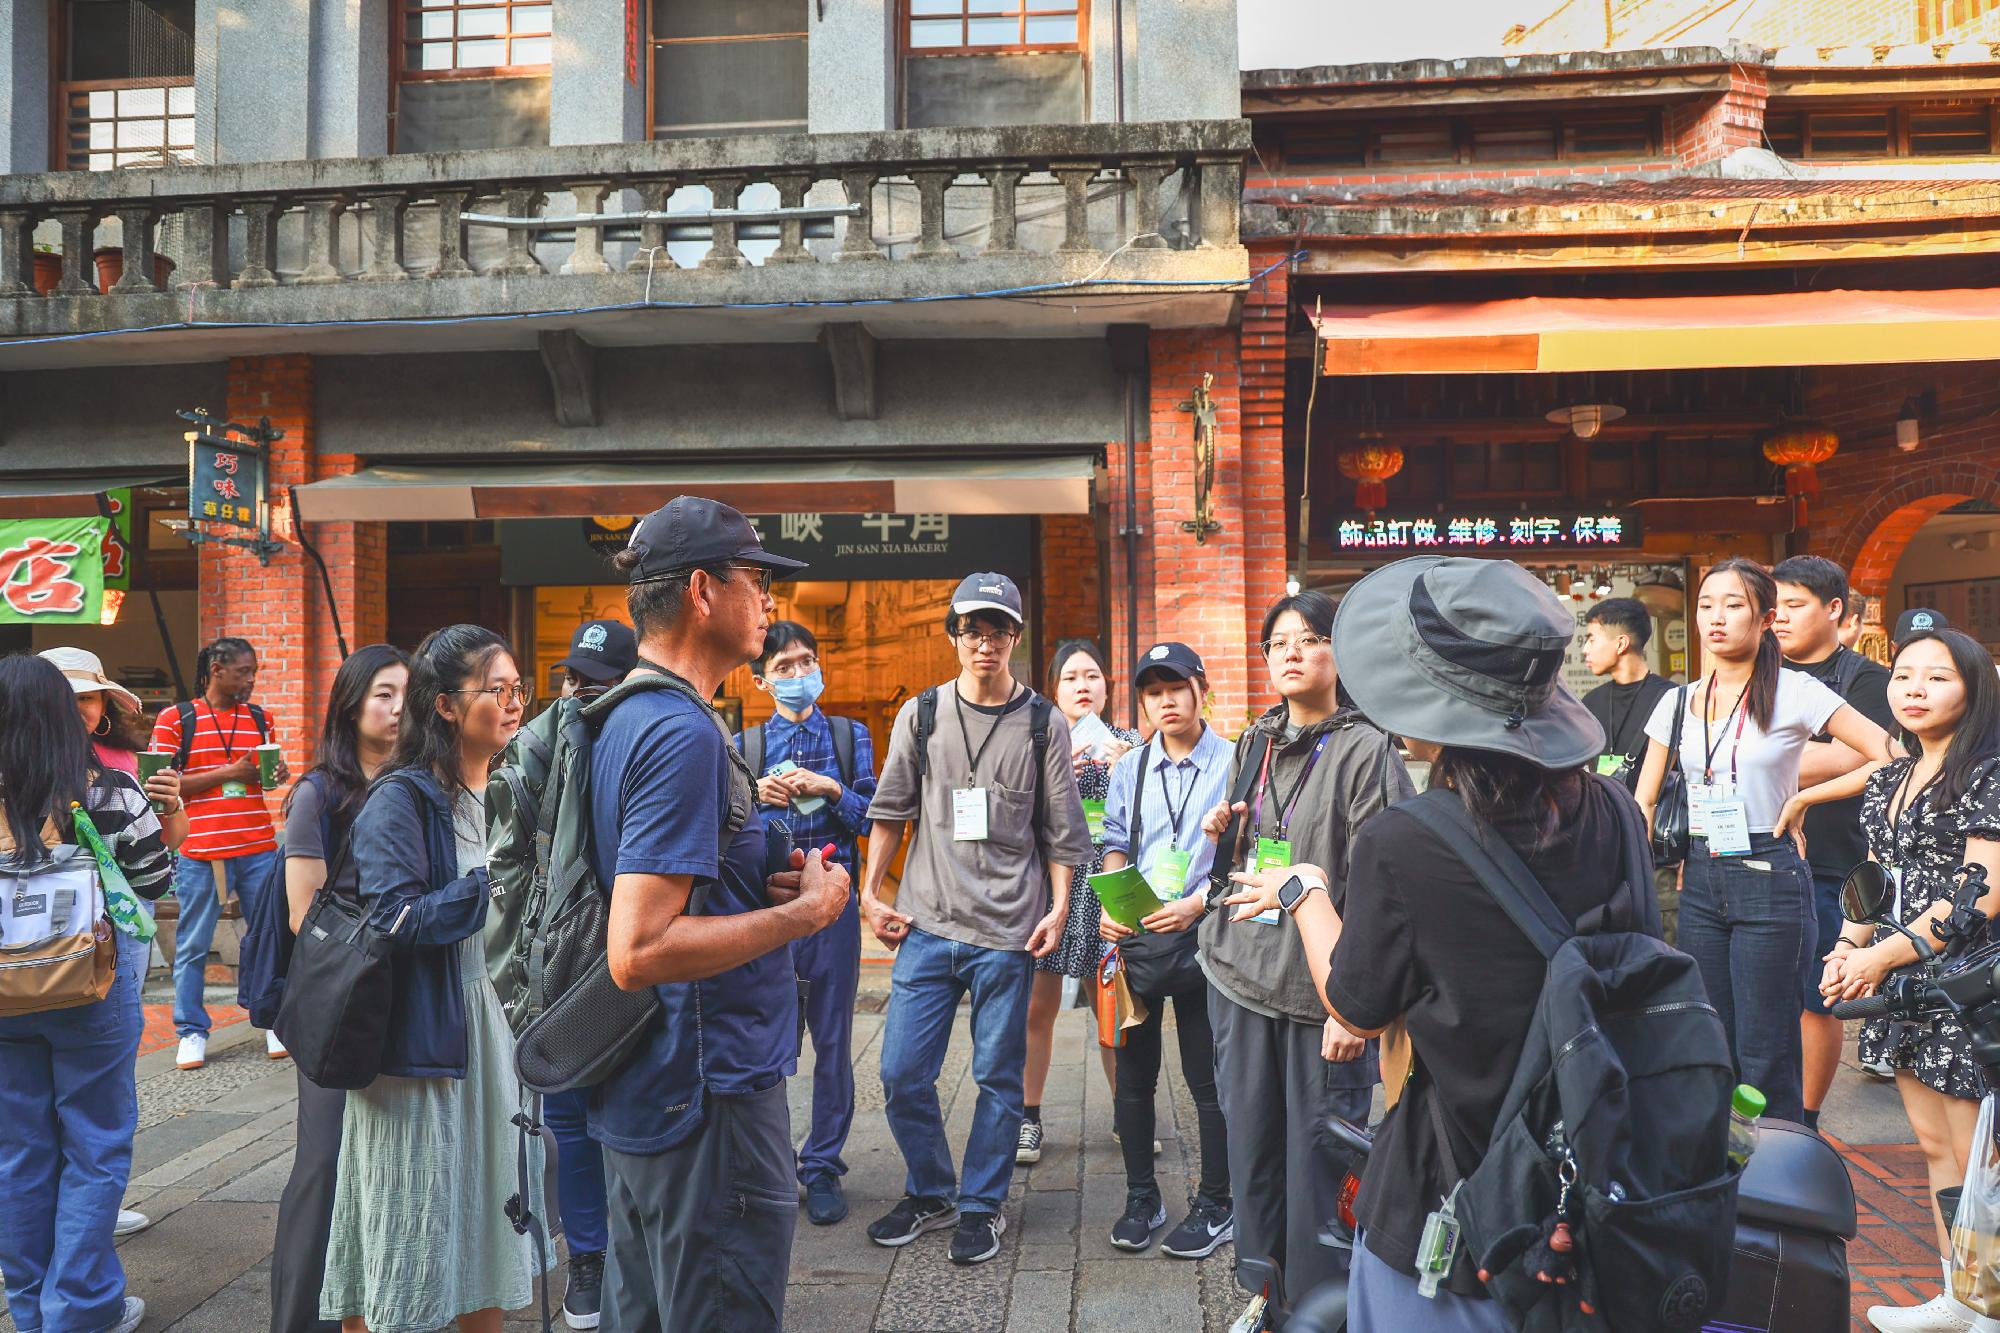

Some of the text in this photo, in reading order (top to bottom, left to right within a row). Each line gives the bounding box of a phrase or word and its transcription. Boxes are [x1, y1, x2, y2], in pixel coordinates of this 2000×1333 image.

[214, 453, 240, 500] 巧味
[835, 543, 948, 556] JIN SAN XIA BAKERY
[0, 537, 84, 615] 店
